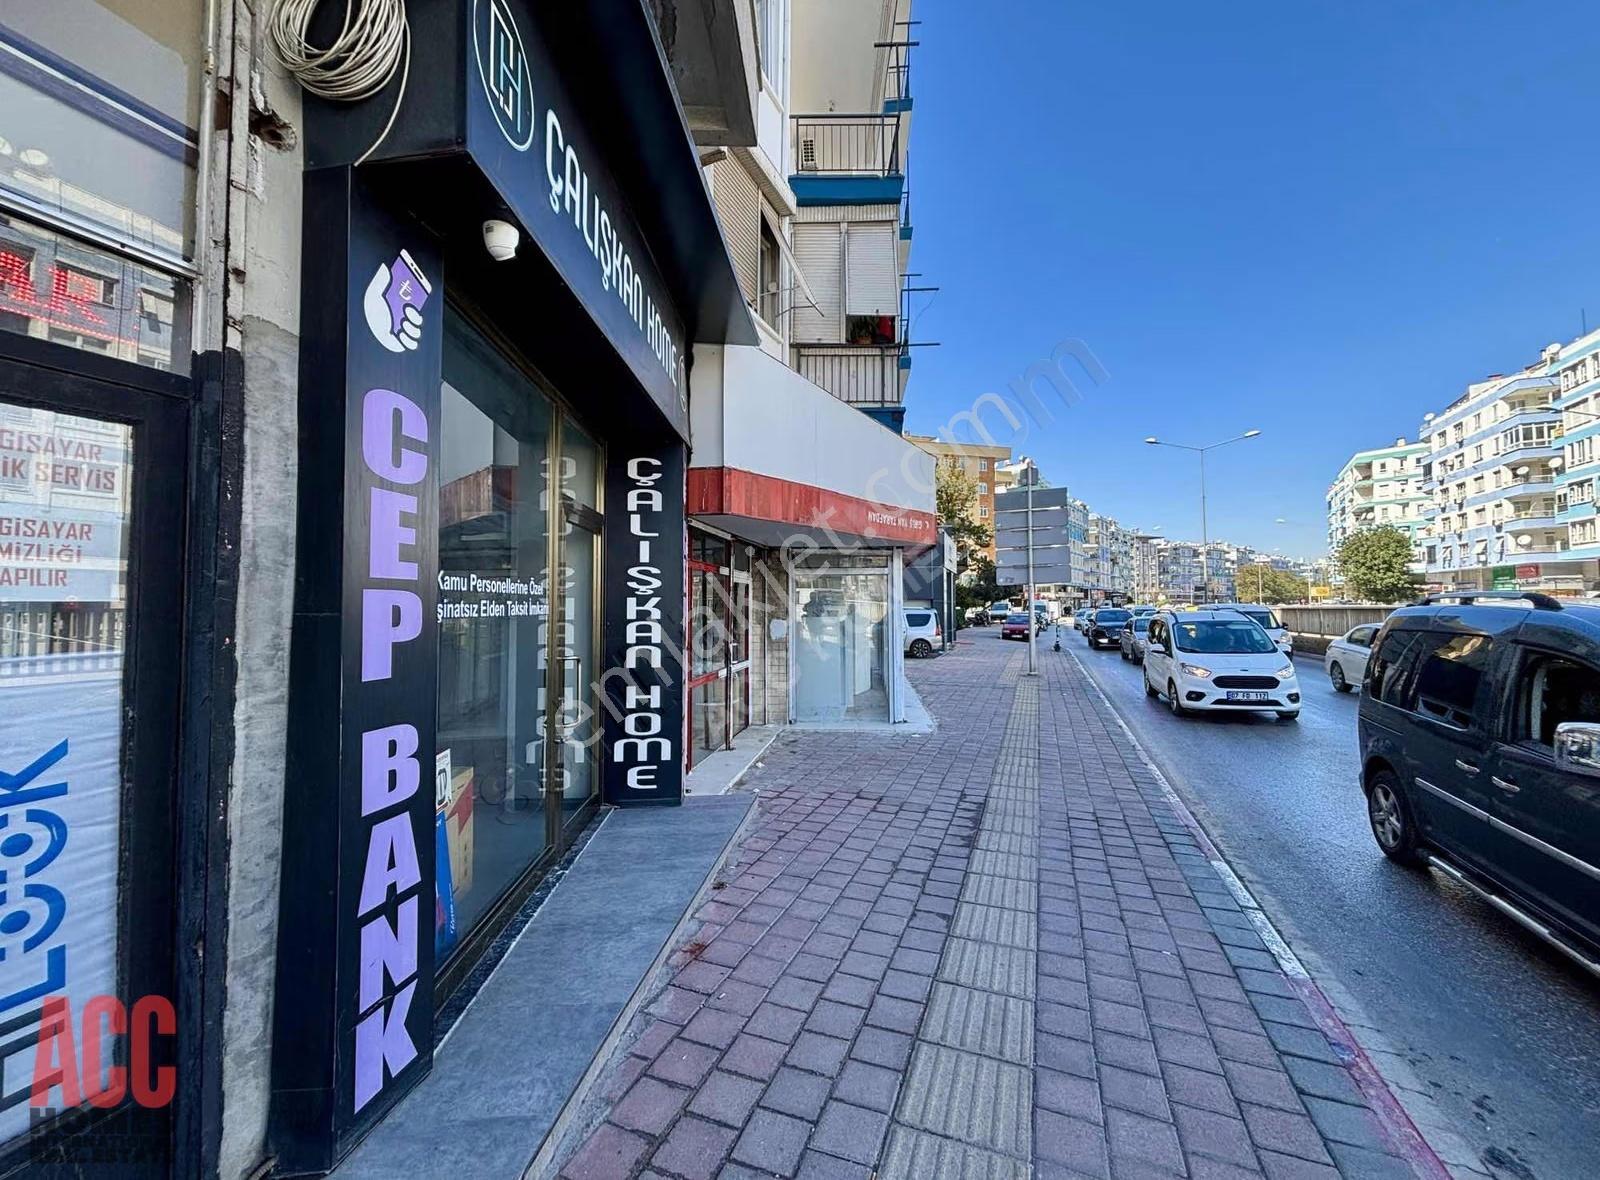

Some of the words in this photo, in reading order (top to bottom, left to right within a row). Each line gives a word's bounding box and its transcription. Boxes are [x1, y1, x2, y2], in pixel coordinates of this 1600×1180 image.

[545, 108, 643, 331] ÇALIŞKAN
[647, 295, 677, 387] HOME
[361, 388, 428, 682] CEP
[470, 573, 528, 596] Personellerine
[480, 599, 505, 617] Elden
[506, 599, 528, 617] Taksit
[626, 457, 663, 669] ÇALIŞKAN
[613, 685, 671, 789] HOME
[354, 723, 422, 1115] BANK
